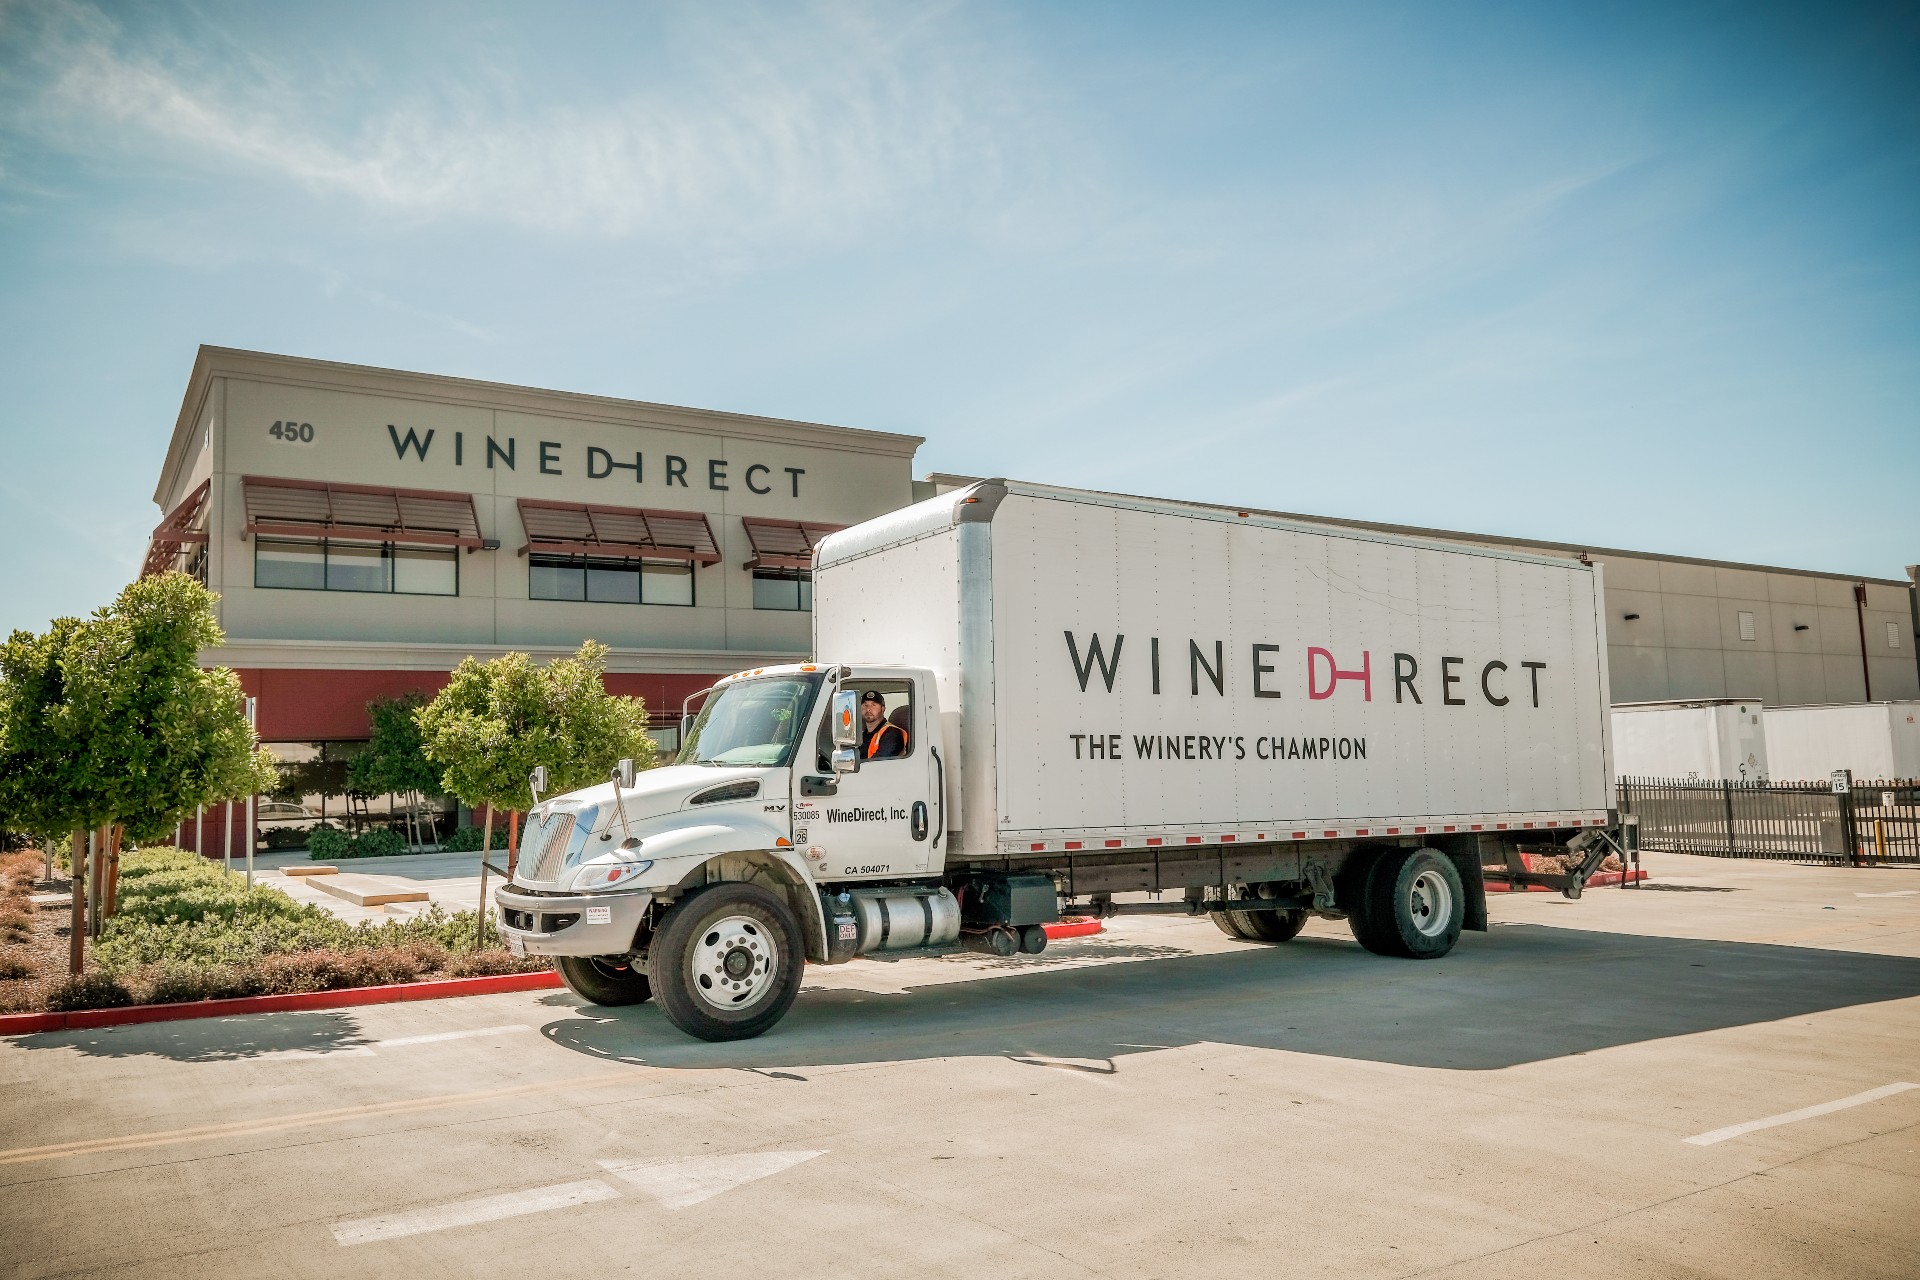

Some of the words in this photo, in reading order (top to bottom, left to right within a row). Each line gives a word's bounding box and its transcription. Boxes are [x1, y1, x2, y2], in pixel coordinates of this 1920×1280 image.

[269, 420, 314, 443] 450
[1069, 734, 1122, 760] THE
[1132, 734, 1246, 761] WINERY'S
[1256, 736, 1366, 761] CHAMPION
[1835, 782, 1845, 791] 15
[793, 810, 820, 821] 530085
[826, 807, 888, 824] WineDirect,
[890, 806, 909, 821] Inc.
[796, 833, 807, 843] 26
[844, 866, 858, 875] CA
[860, 864, 891, 874] 504071
[840, 924, 855, 933] DEF
